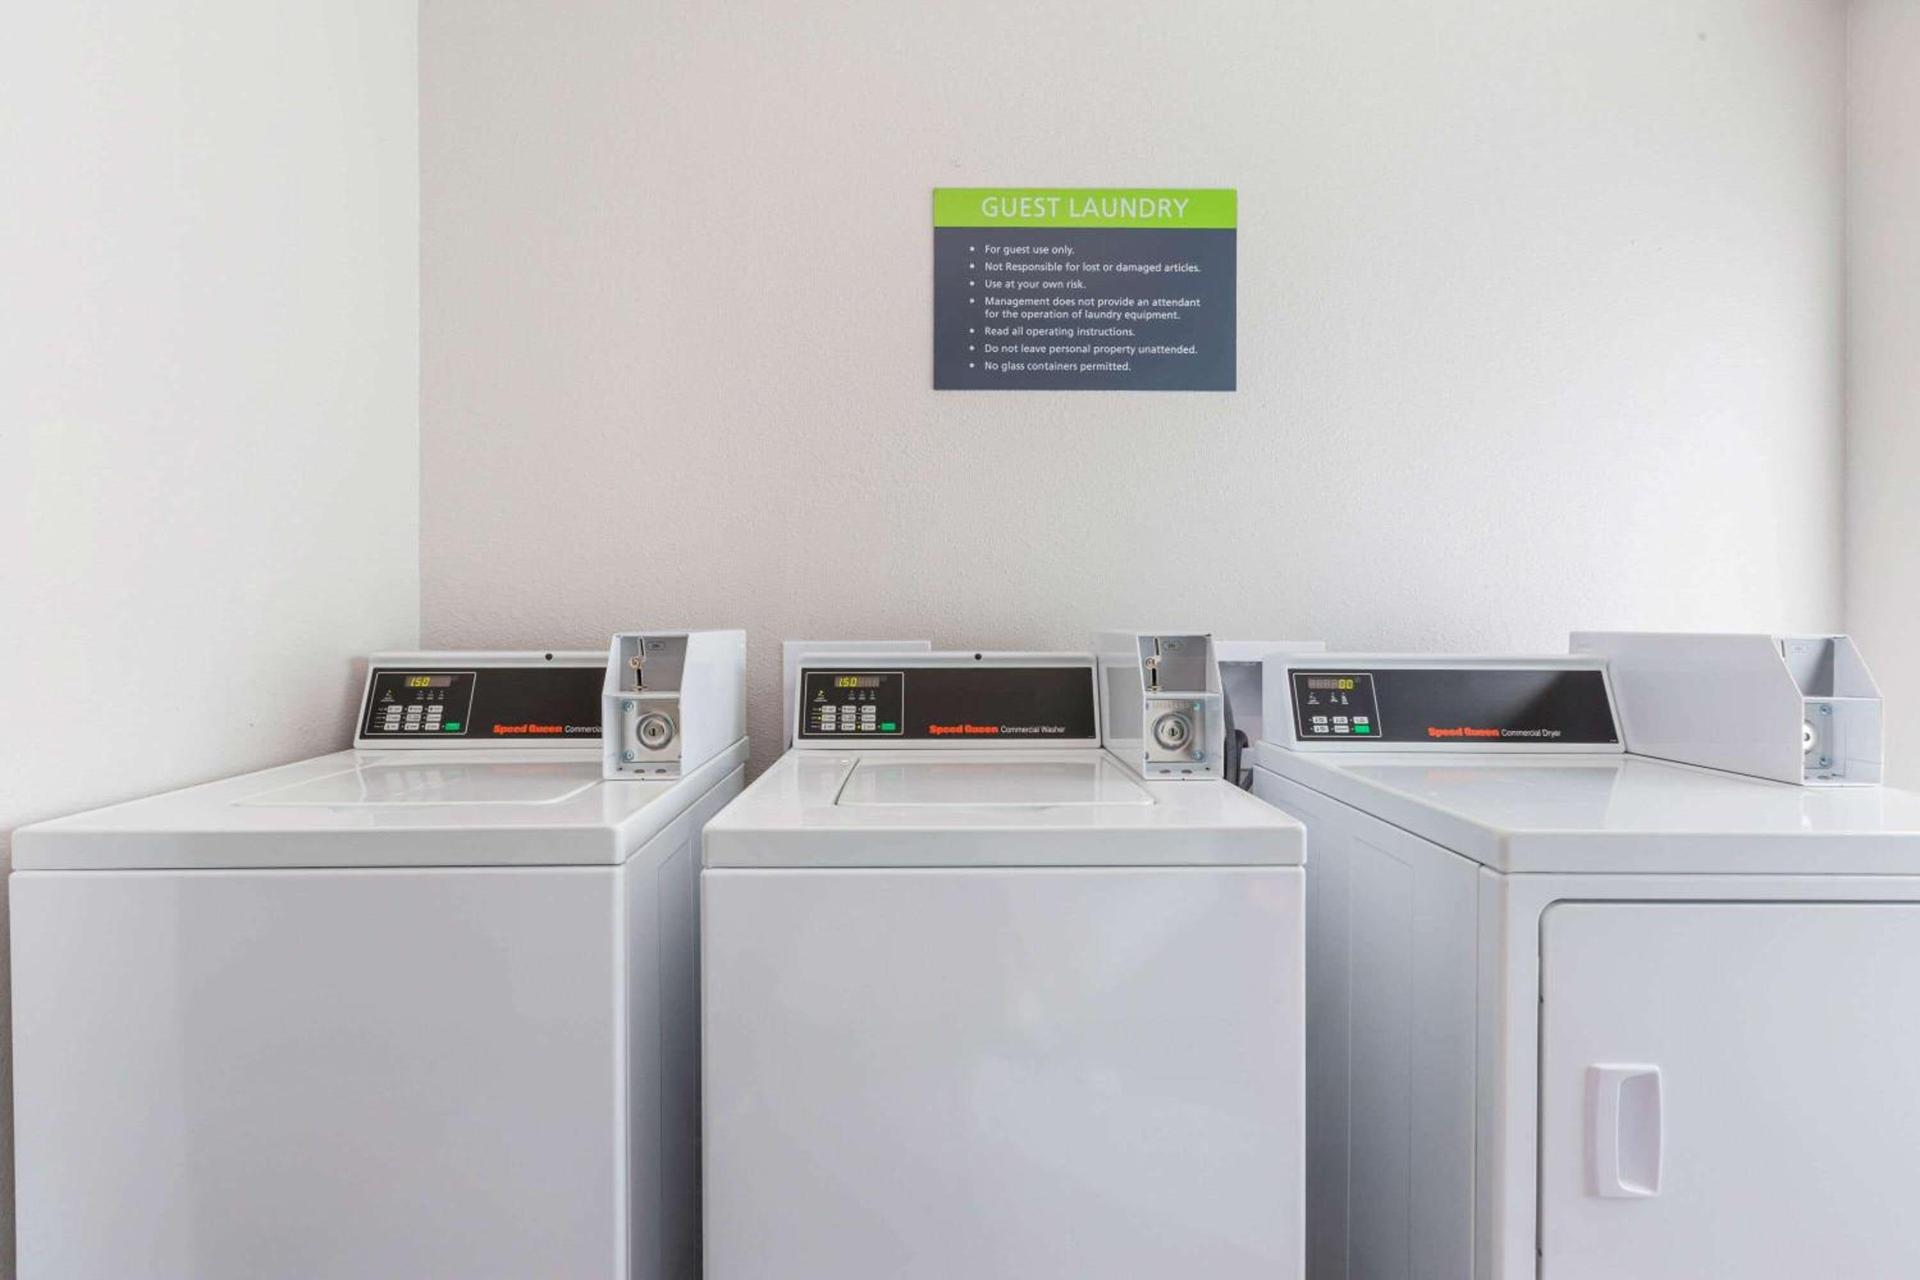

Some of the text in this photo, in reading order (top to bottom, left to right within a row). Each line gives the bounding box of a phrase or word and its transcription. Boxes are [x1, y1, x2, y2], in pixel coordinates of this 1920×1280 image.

[981, 197, 1190, 218] GUEST LAUNDRY
[985, 245, 1000, 254] For
[1003, 246, 1030, 256] guest
[1052, 245, 1075, 256] only.
[985, 262, 1201, 274] Not Responsible for lost or damaged articles.
[985, 280, 1002, 288] Use
[1005, 280, 1015, 288] at
[1017, 281, 1039, 290] your
[1067, 279, 1086, 288] risk.
[985, 297, 1050, 308] Management
[1053, 297, 1075, 306] does
[1078, 298, 1095, 306] not
[1098, 297, 1134, 308] provide
[1152, 297, 1201, 307] attendant
[985, 309, 1181, 321] for the operation of laundry equipment.
[985, 327, 1136, 338] Read all operating instructions.
[985, 344, 1198, 356] Do not leave personal property unattended.
[985, 361, 1132, 372] No glass containers permitted.
[494, 724, 602, 735] Speed Queen Commercia
[929, 725, 963, 734] Speed
[964, 725, 998, 734] Queen
[1000, 725, 1040, 733] Commercial
[1428, 727, 1463, 737] Speed
[1464, 727, 1499, 736] Queen
[1501, 728, 1541, 737] Commercial
